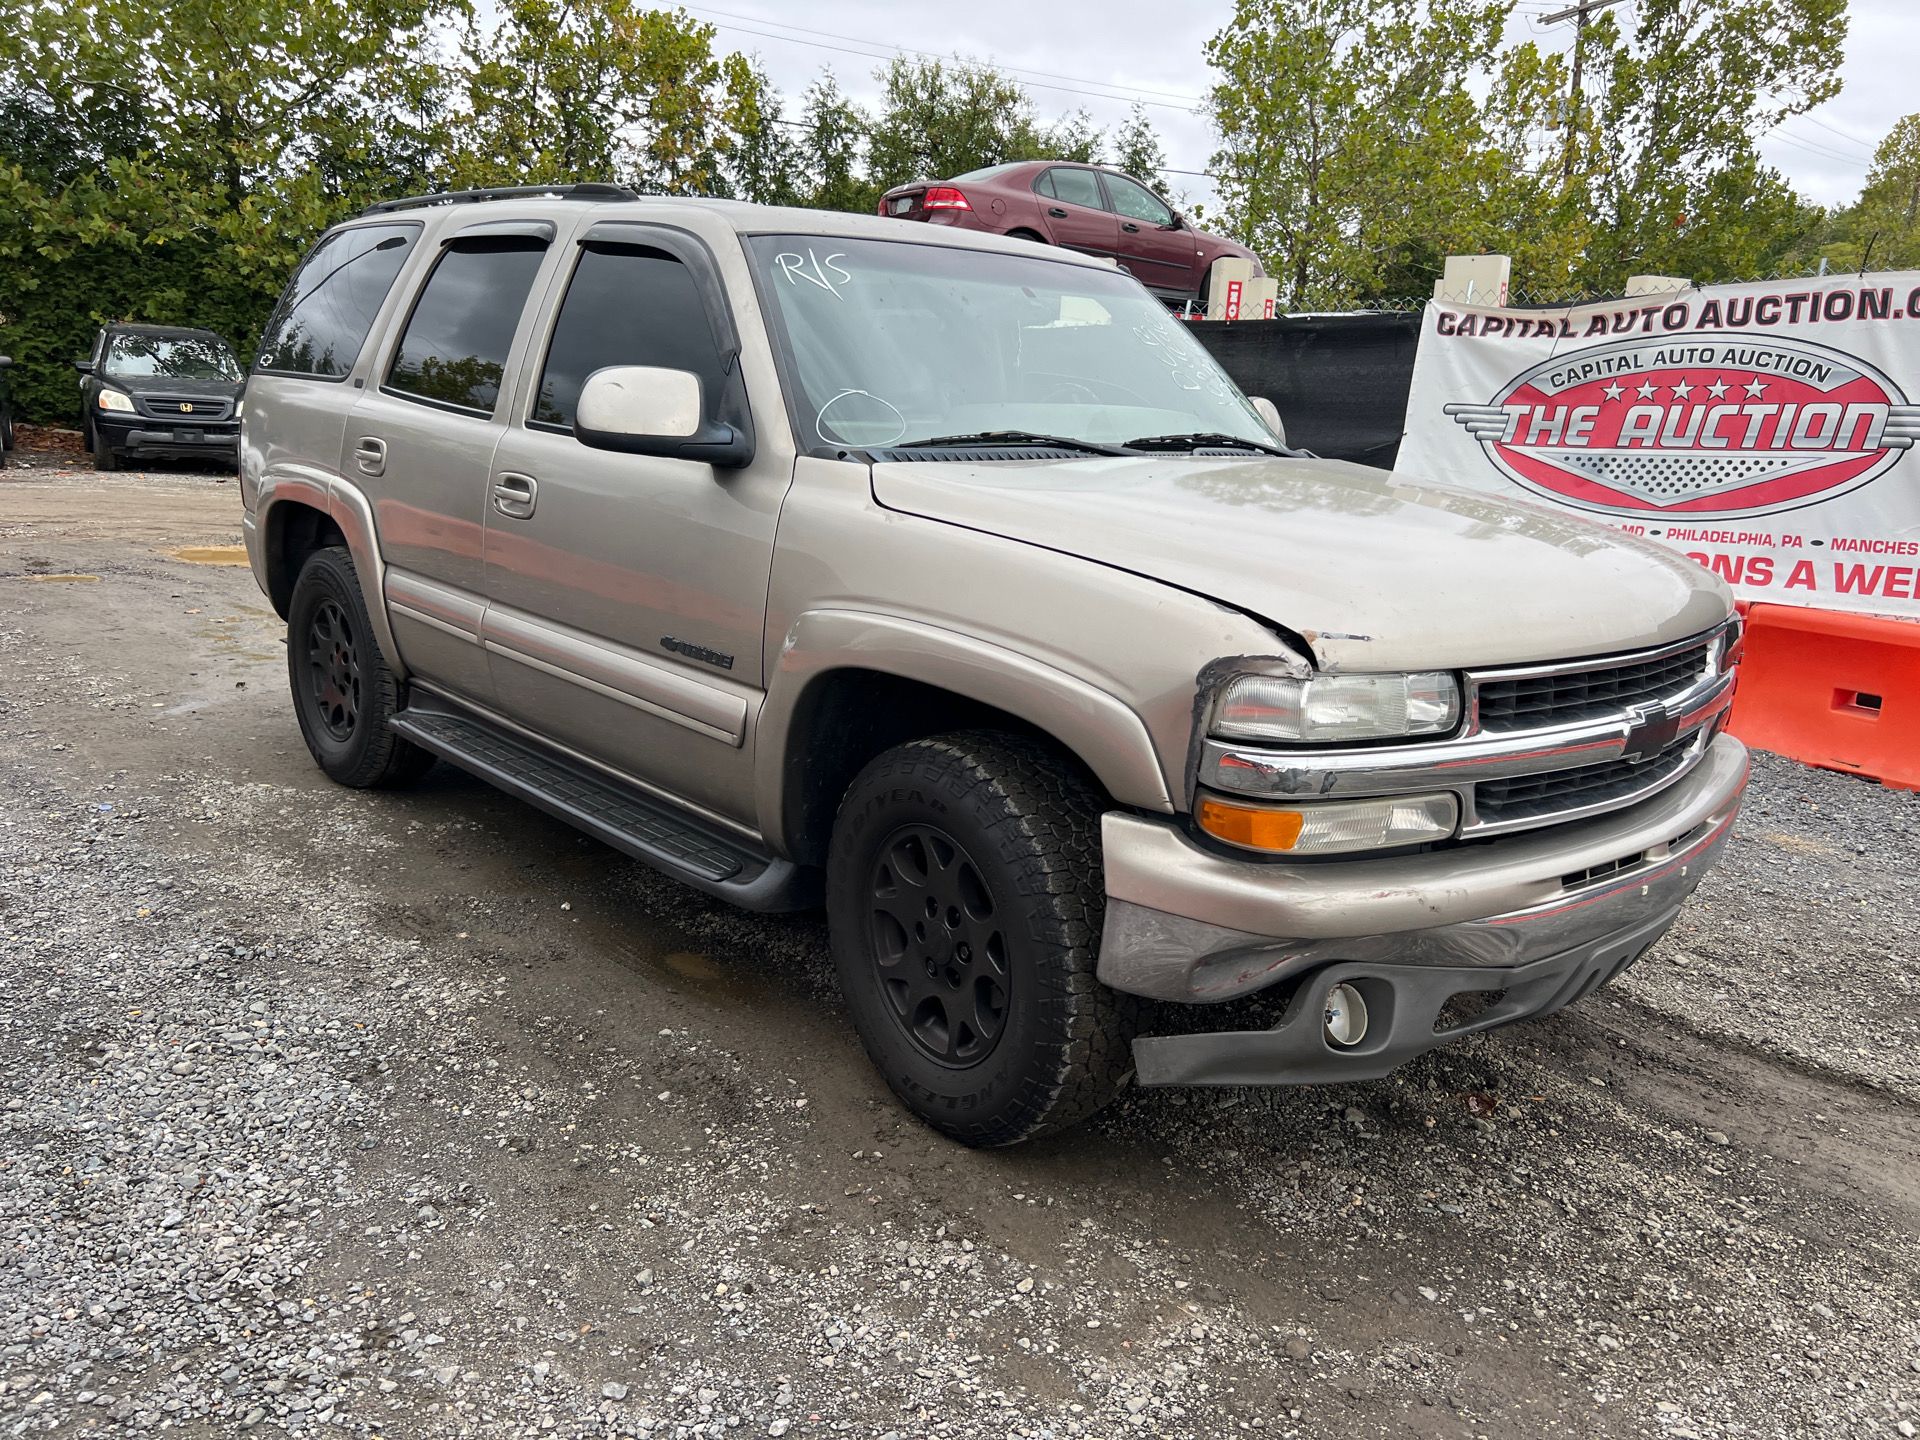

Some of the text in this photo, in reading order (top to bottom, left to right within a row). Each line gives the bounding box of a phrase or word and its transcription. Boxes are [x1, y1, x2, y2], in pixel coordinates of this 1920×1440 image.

[1436, 311, 1578, 338] CAPITAL
[1583, 303, 1690, 338] AUTO
[1549, 348, 1832, 389] CAPITAL AUTO AUCTION
[1499, 402, 1892, 451] THE AUCTION
[1666, 527, 1776, 548] PHILADELPHIA,
[1781, 535, 1803, 549] PA
[1830, 537, 1919, 556] MANCHES
[1784, 559, 1817, 592] A
